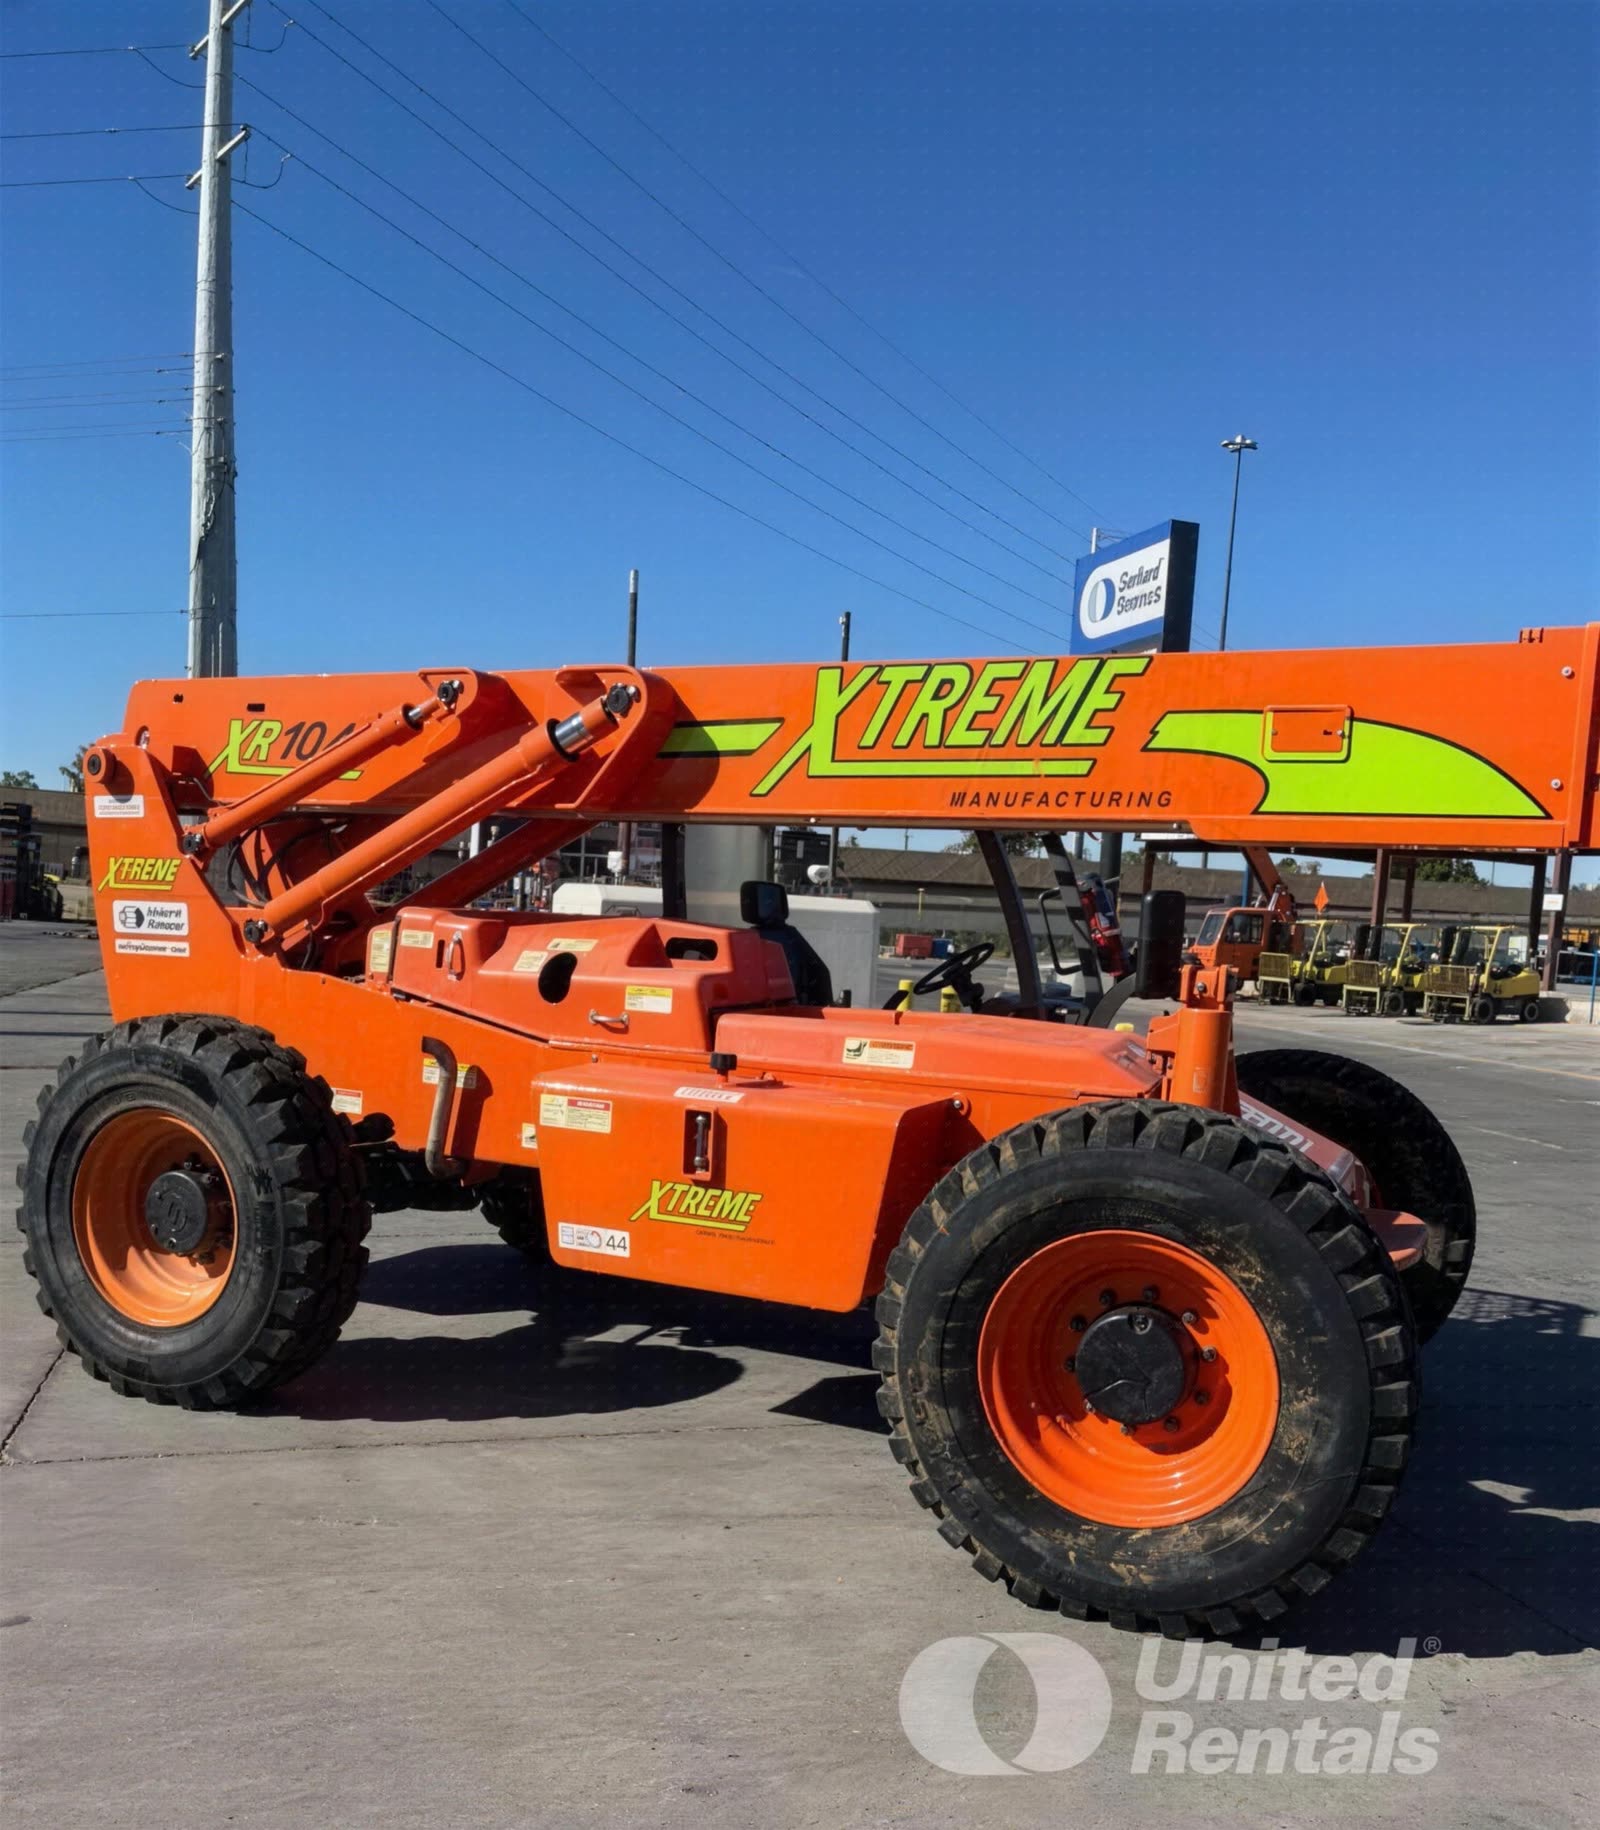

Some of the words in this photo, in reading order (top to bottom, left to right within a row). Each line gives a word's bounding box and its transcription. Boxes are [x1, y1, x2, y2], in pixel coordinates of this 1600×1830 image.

[750, 656, 1153, 797] XTREME
[950, 790, 1174, 808] MANUFACTURING
[628, 1179, 763, 1232] XTREME
[606, 1235, 628, 1251] 44
